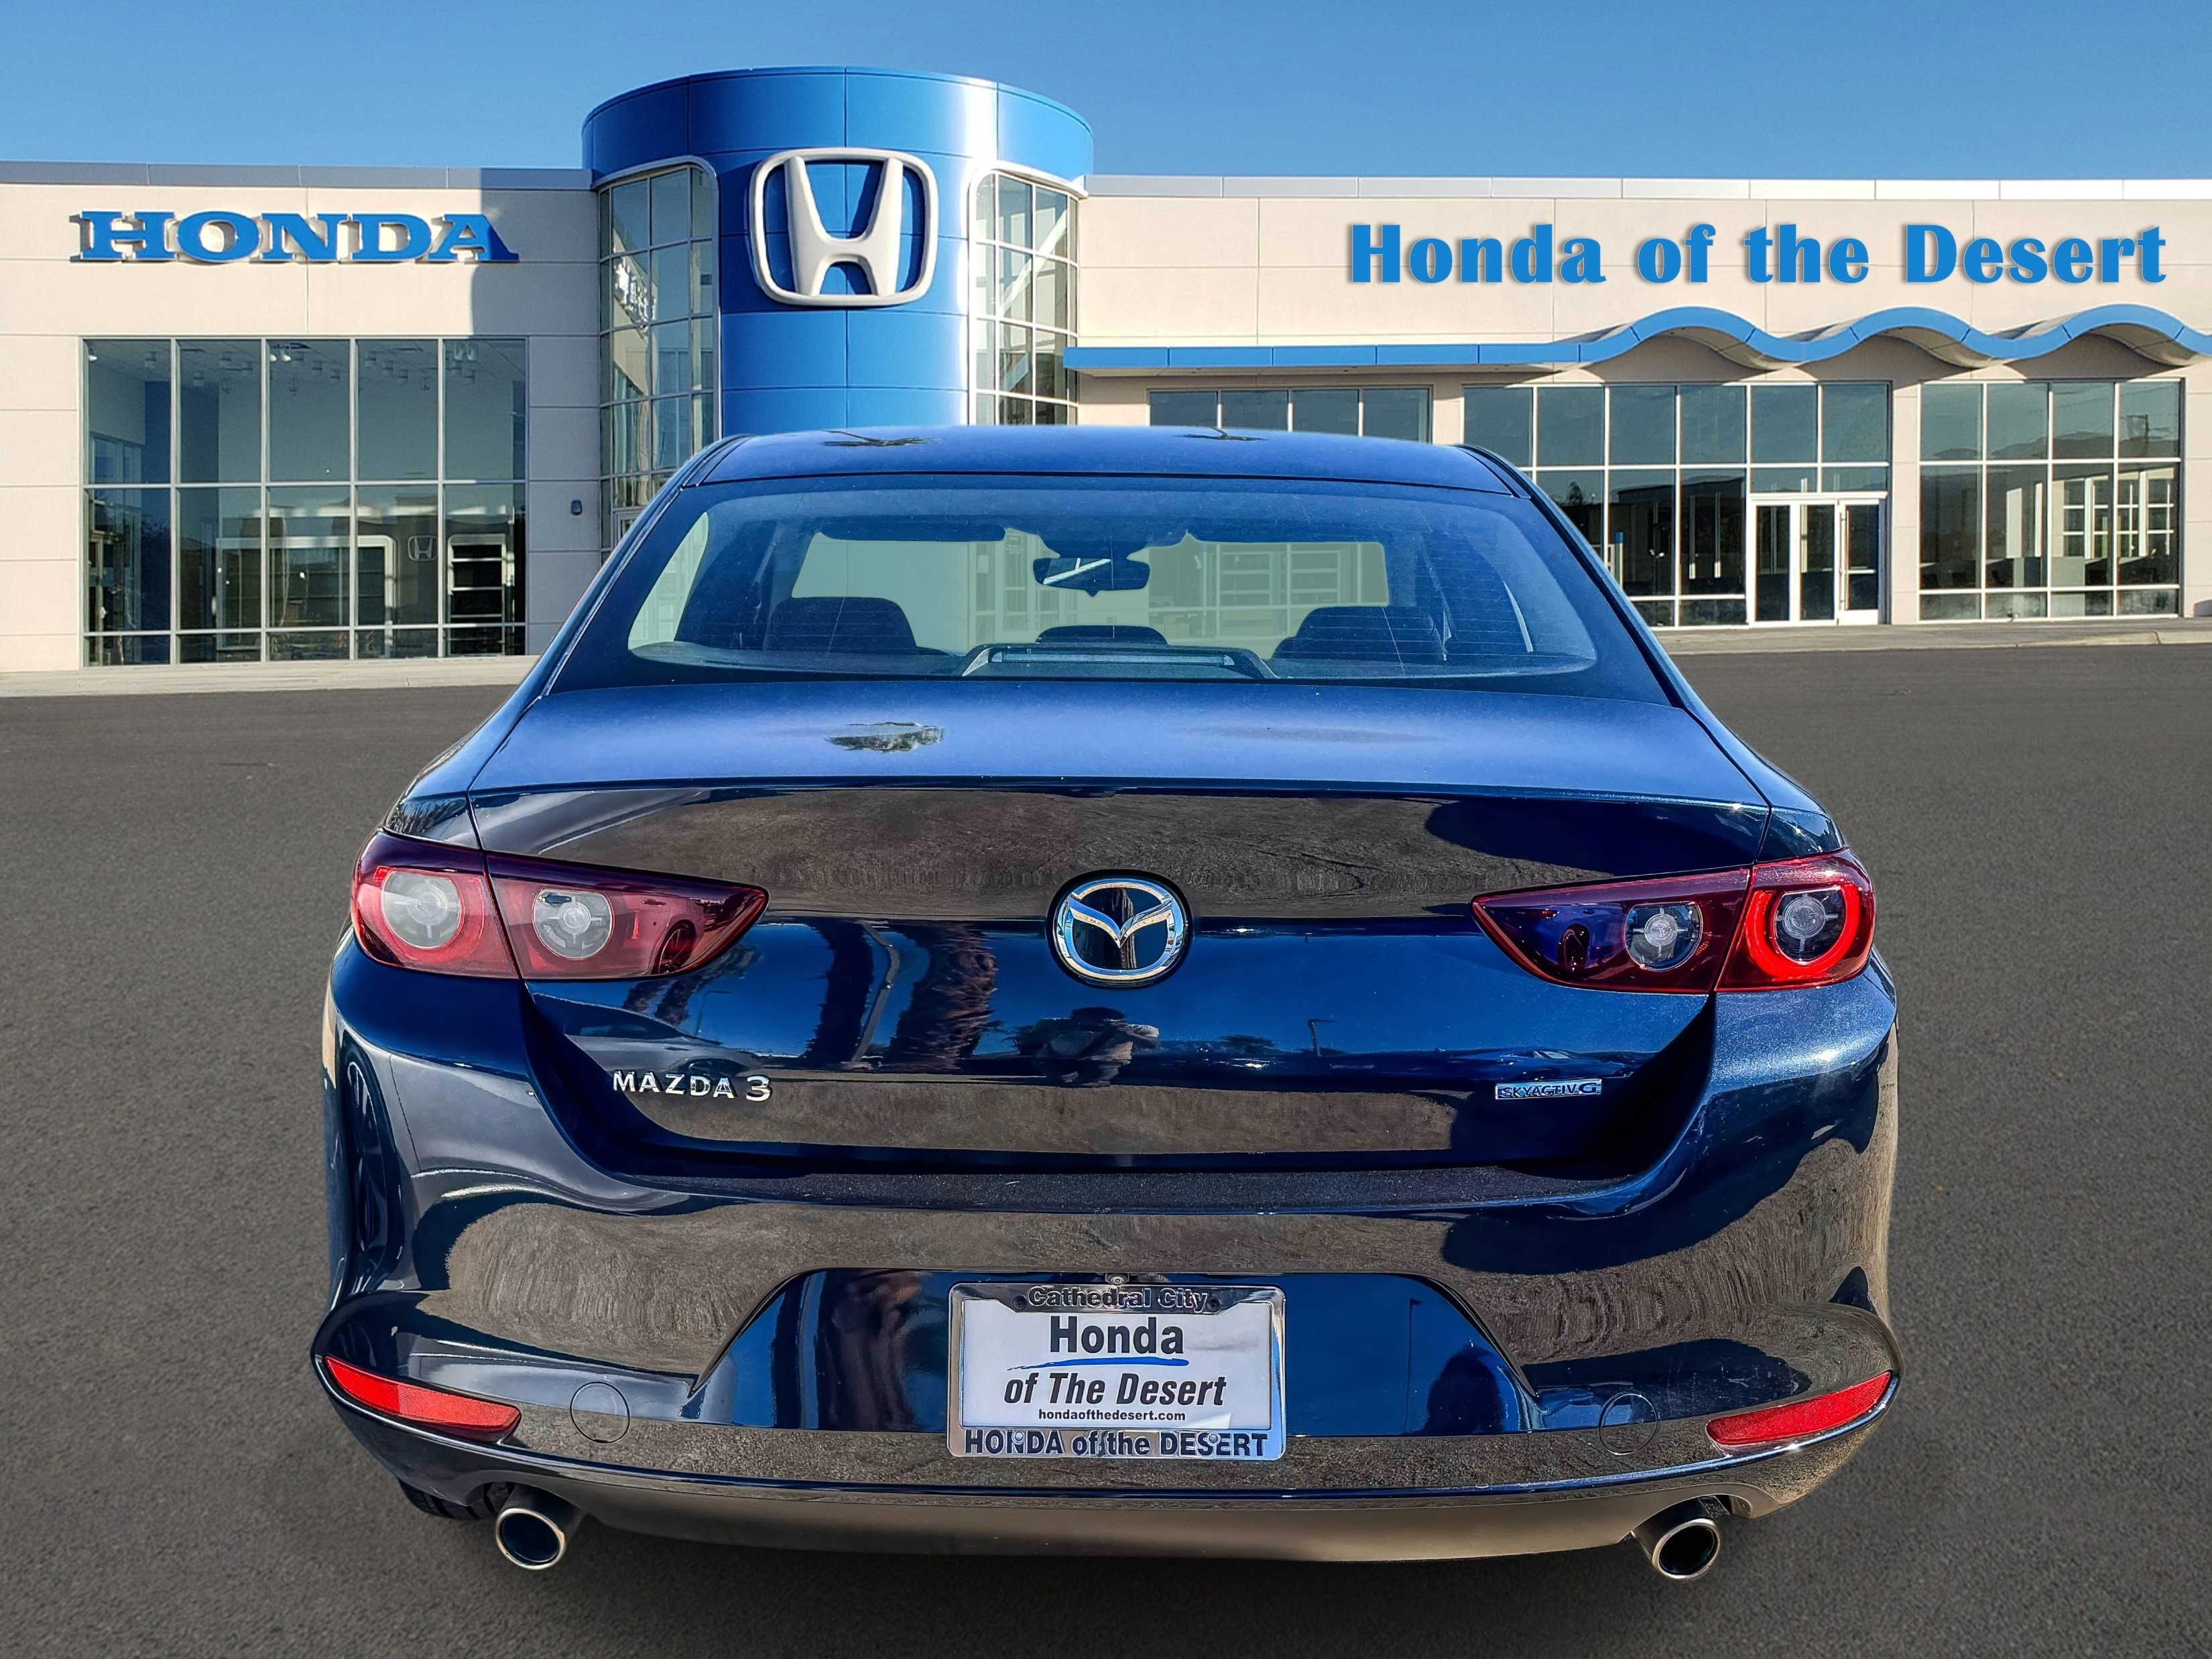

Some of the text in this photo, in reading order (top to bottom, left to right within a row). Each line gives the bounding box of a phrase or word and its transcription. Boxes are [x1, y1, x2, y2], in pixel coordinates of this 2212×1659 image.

[78, 210, 520, 262] HONDA
[1351, 224, 2167, 284] Honda of the Desert
[613, 1070, 771, 1102] MAZDA 3
[1028, 1286, 1208, 1314] Cathedral City
[1050, 1315, 1184, 1355] Honda
[1004, 1372, 1227, 1406] of The Desert
[1038, 1408, 1186, 1422] hondaofthedesert.com
[965, 1429, 1268, 1457] HONDA of the DESERT
